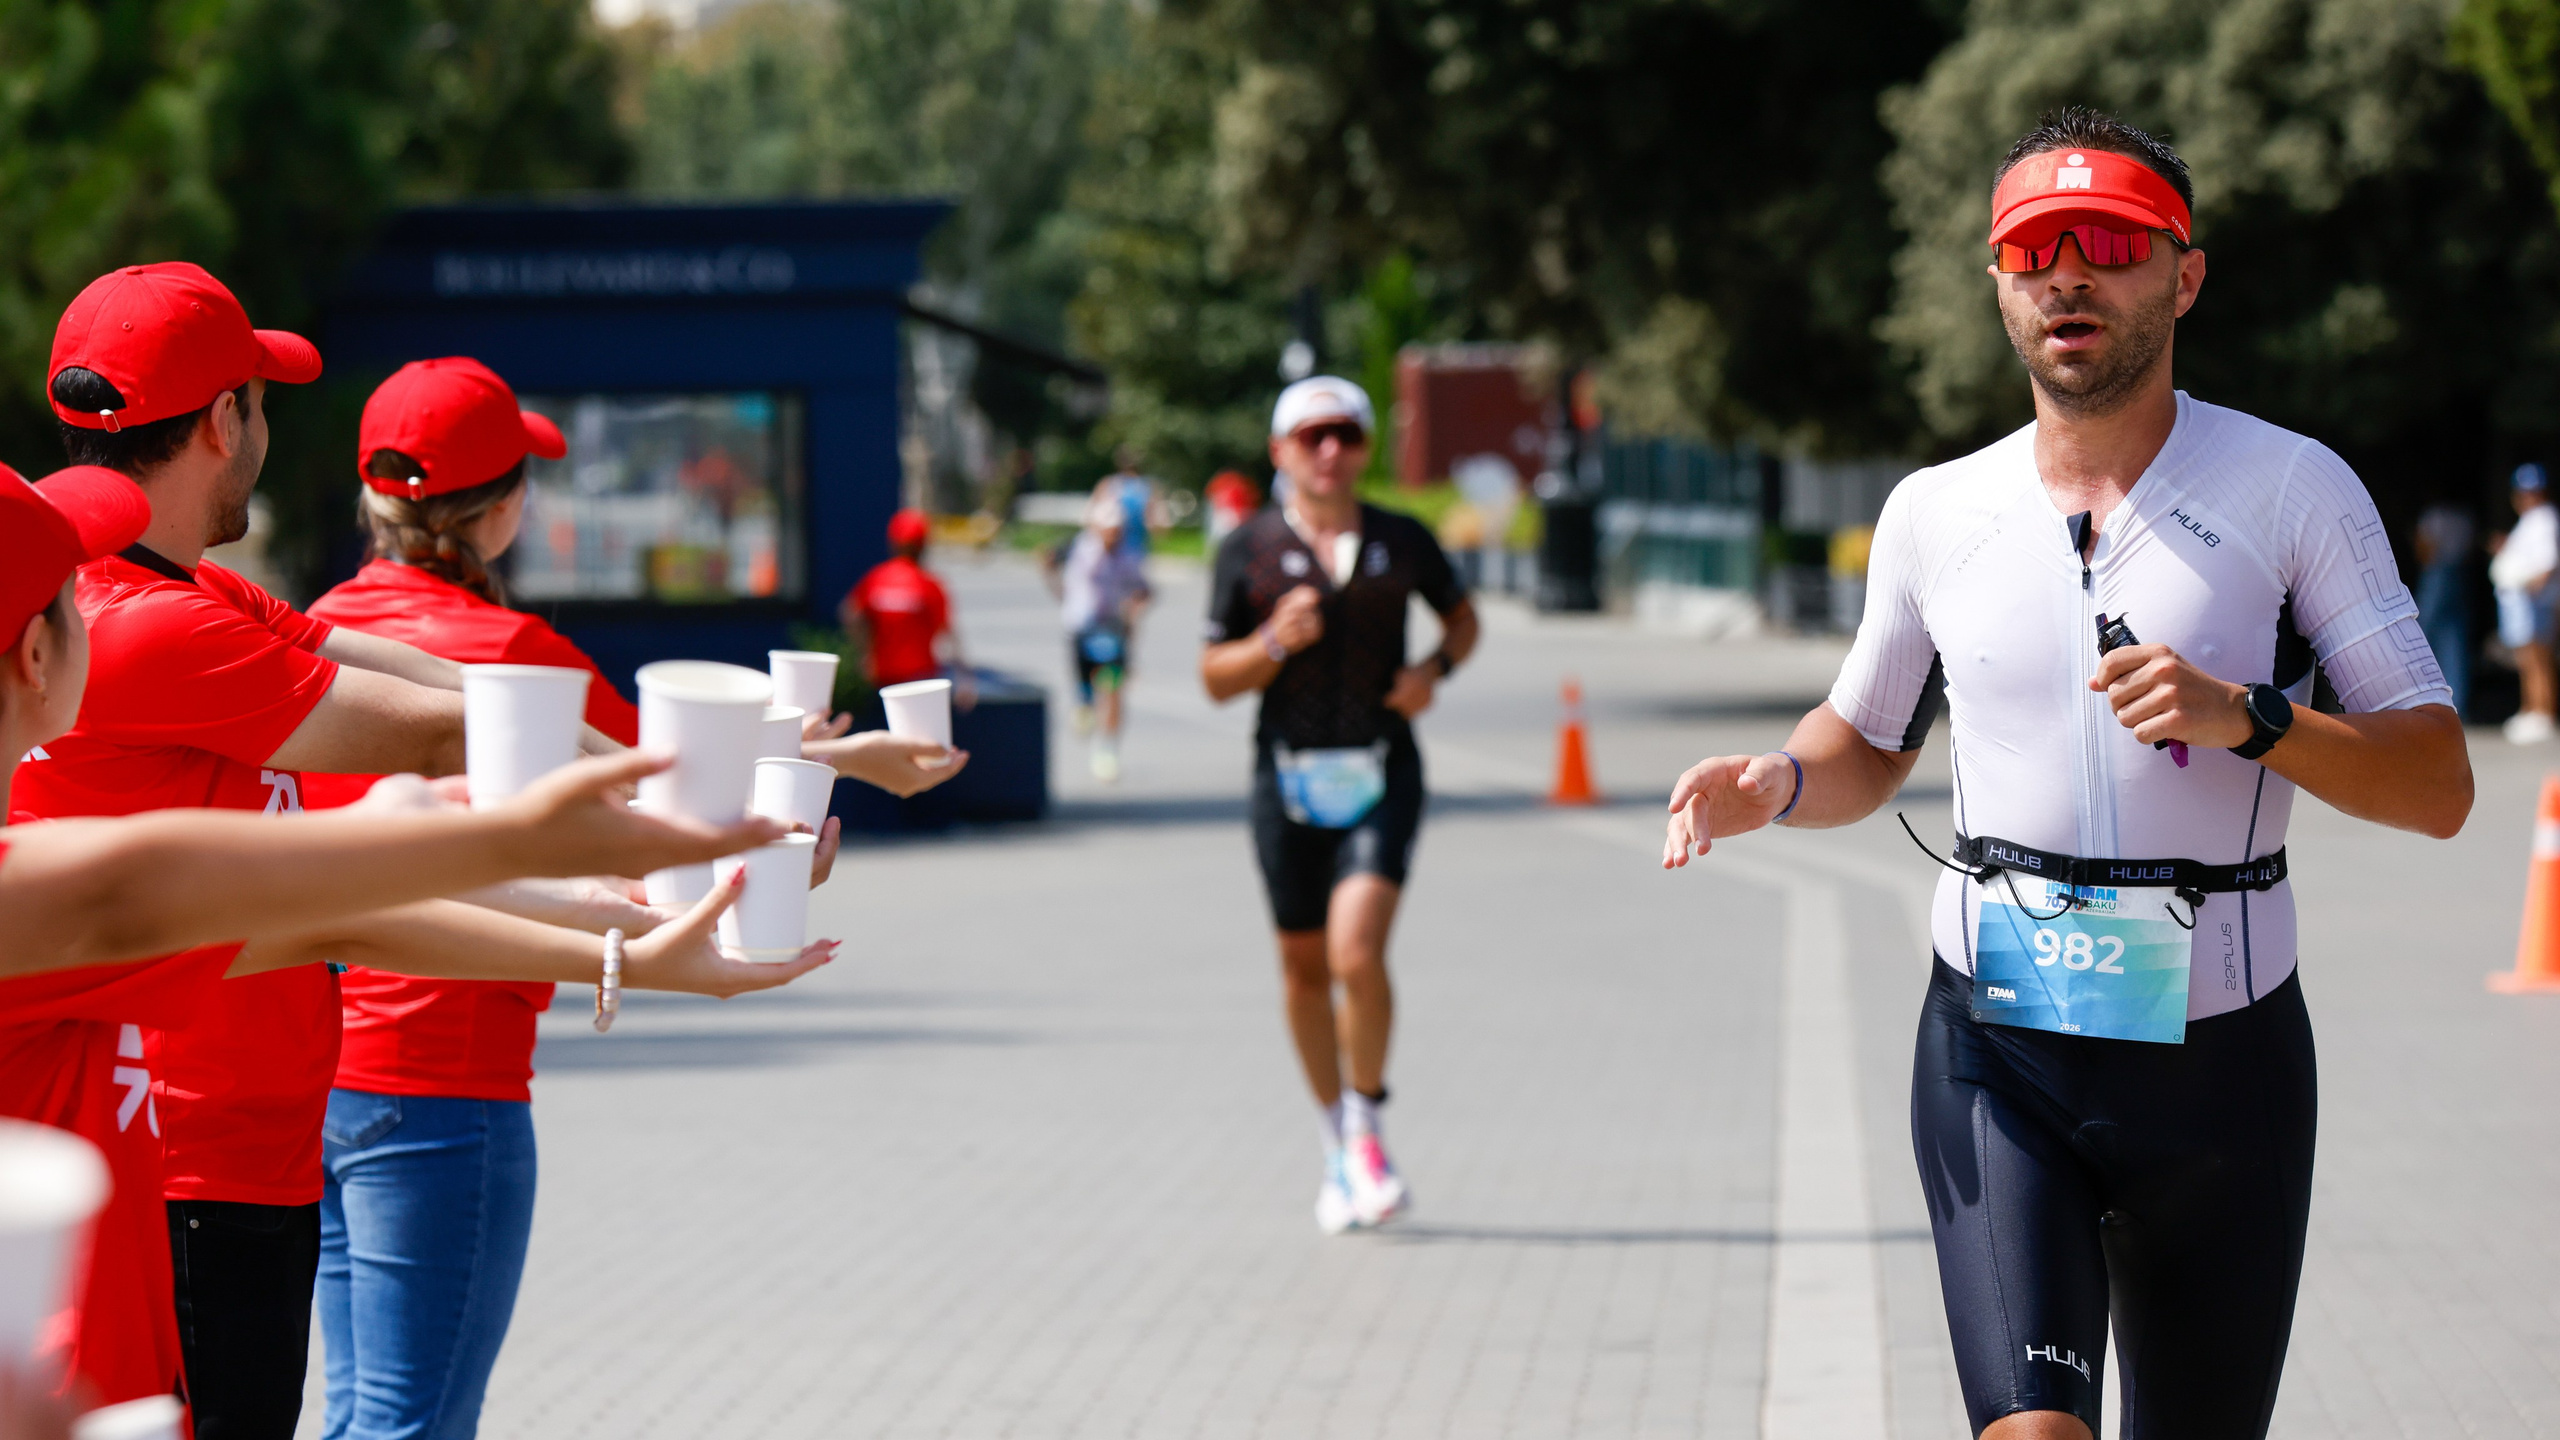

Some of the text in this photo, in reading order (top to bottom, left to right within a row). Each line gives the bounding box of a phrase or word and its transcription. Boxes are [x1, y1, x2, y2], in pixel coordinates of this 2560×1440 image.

[2169, 508, 2221, 548] HUUB
[1988, 844, 2042, 870] HUUB
[2109, 866, 2175, 880] HUUB
[2045, 895, 2117, 911] 70. BAKU
[2033, 927, 2125, 975] 982
[2220, 922, 2238, 991] 22PLUS
[2060, 1022, 2081, 1033] 2026
[2025, 1344, 2091, 1384] HUUB
